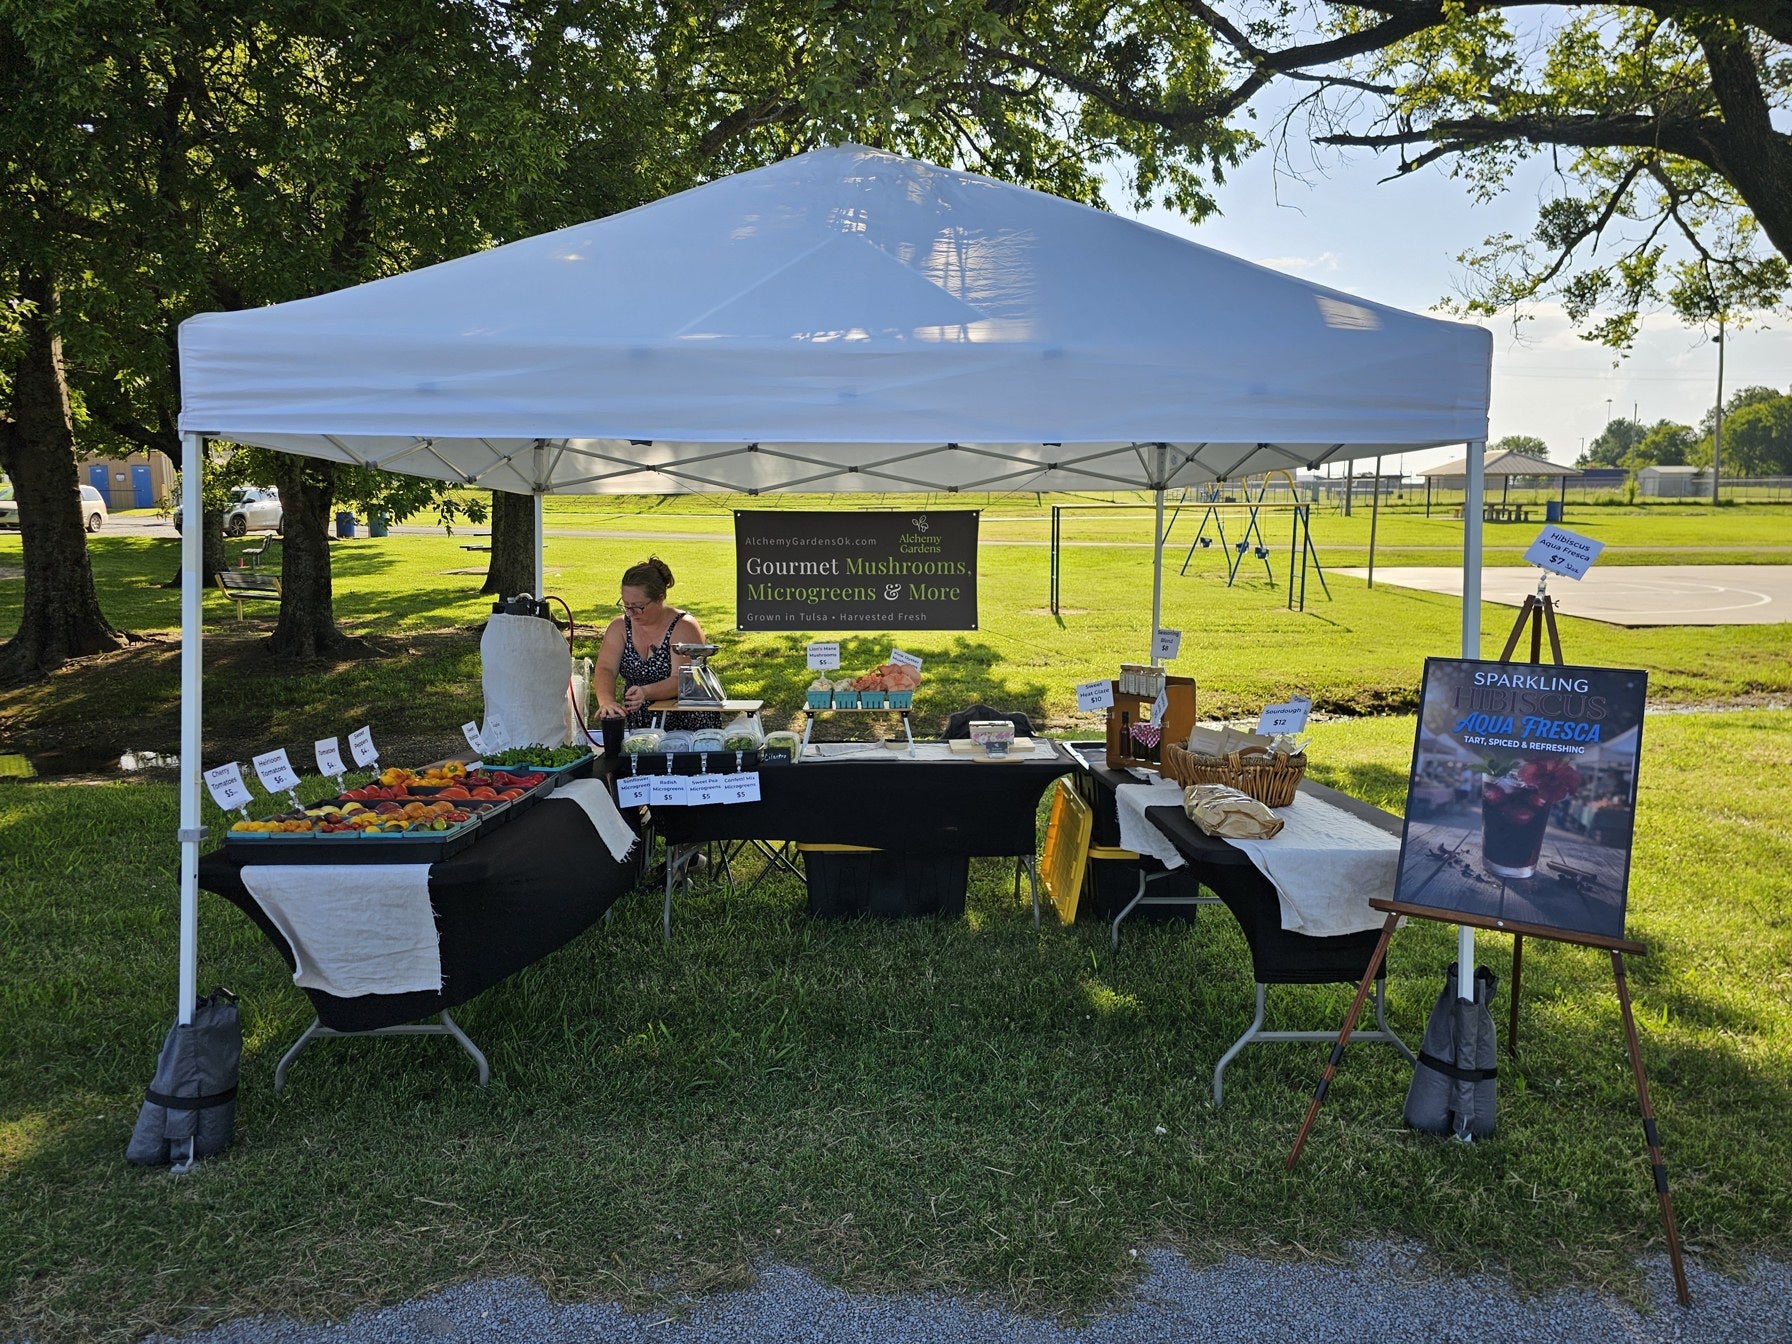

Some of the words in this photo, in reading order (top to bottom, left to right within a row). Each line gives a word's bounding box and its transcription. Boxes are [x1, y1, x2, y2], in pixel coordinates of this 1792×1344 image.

[745, 537, 877, 548] AlchemyGardensOk.com
[900, 534, 941, 544] Alchemy
[1551, 533, 1590, 551] Hibiscus
[900, 544, 941, 553] Gardens
[1539, 539, 1561, 551] Aqua
[1563, 547, 1590, 561] Fresca
[1549, 555, 1565, 565] $7
[746, 557, 840, 576] Gourmet
[846, 556, 972, 577] Mushrooms,
[748, 583, 876, 605] Microgreens
[884, 583, 902, 600] &
[909, 583, 961, 600] More
[747, 612, 781, 622] Grown
[785, 612, 795, 621] in
[800, 612, 828, 622] Tulsa
[840, 612, 894, 622] Harvested
[898, 612, 927, 621] Fresh
[1085, 682, 1103, 690] Sweet
[1473, 672, 1589, 693] SPARKLING
[1080, 690, 1094, 698] Heat
[1453, 686, 1609, 721] HIBISCUS
[1453, 711, 1514, 736] AQUA
[1520, 714, 1600, 743] FRESCA
[1464, 735, 1487, 745] TART,
[1488, 738, 1519, 748] SPICED
[1529, 742, 1585, 754] REFRESHING
[318, 748, 336, 756] Tomatoes
[258, 755, 282, 767] Heirloom
[211, 768, 230, 778] Cherry
[261, 765, 287, 777] Tomatoes
[211, 777, 237, 790] Tomatoes
[274, 775, 284, 784] $6
[224, 788, 234, 798] $5
